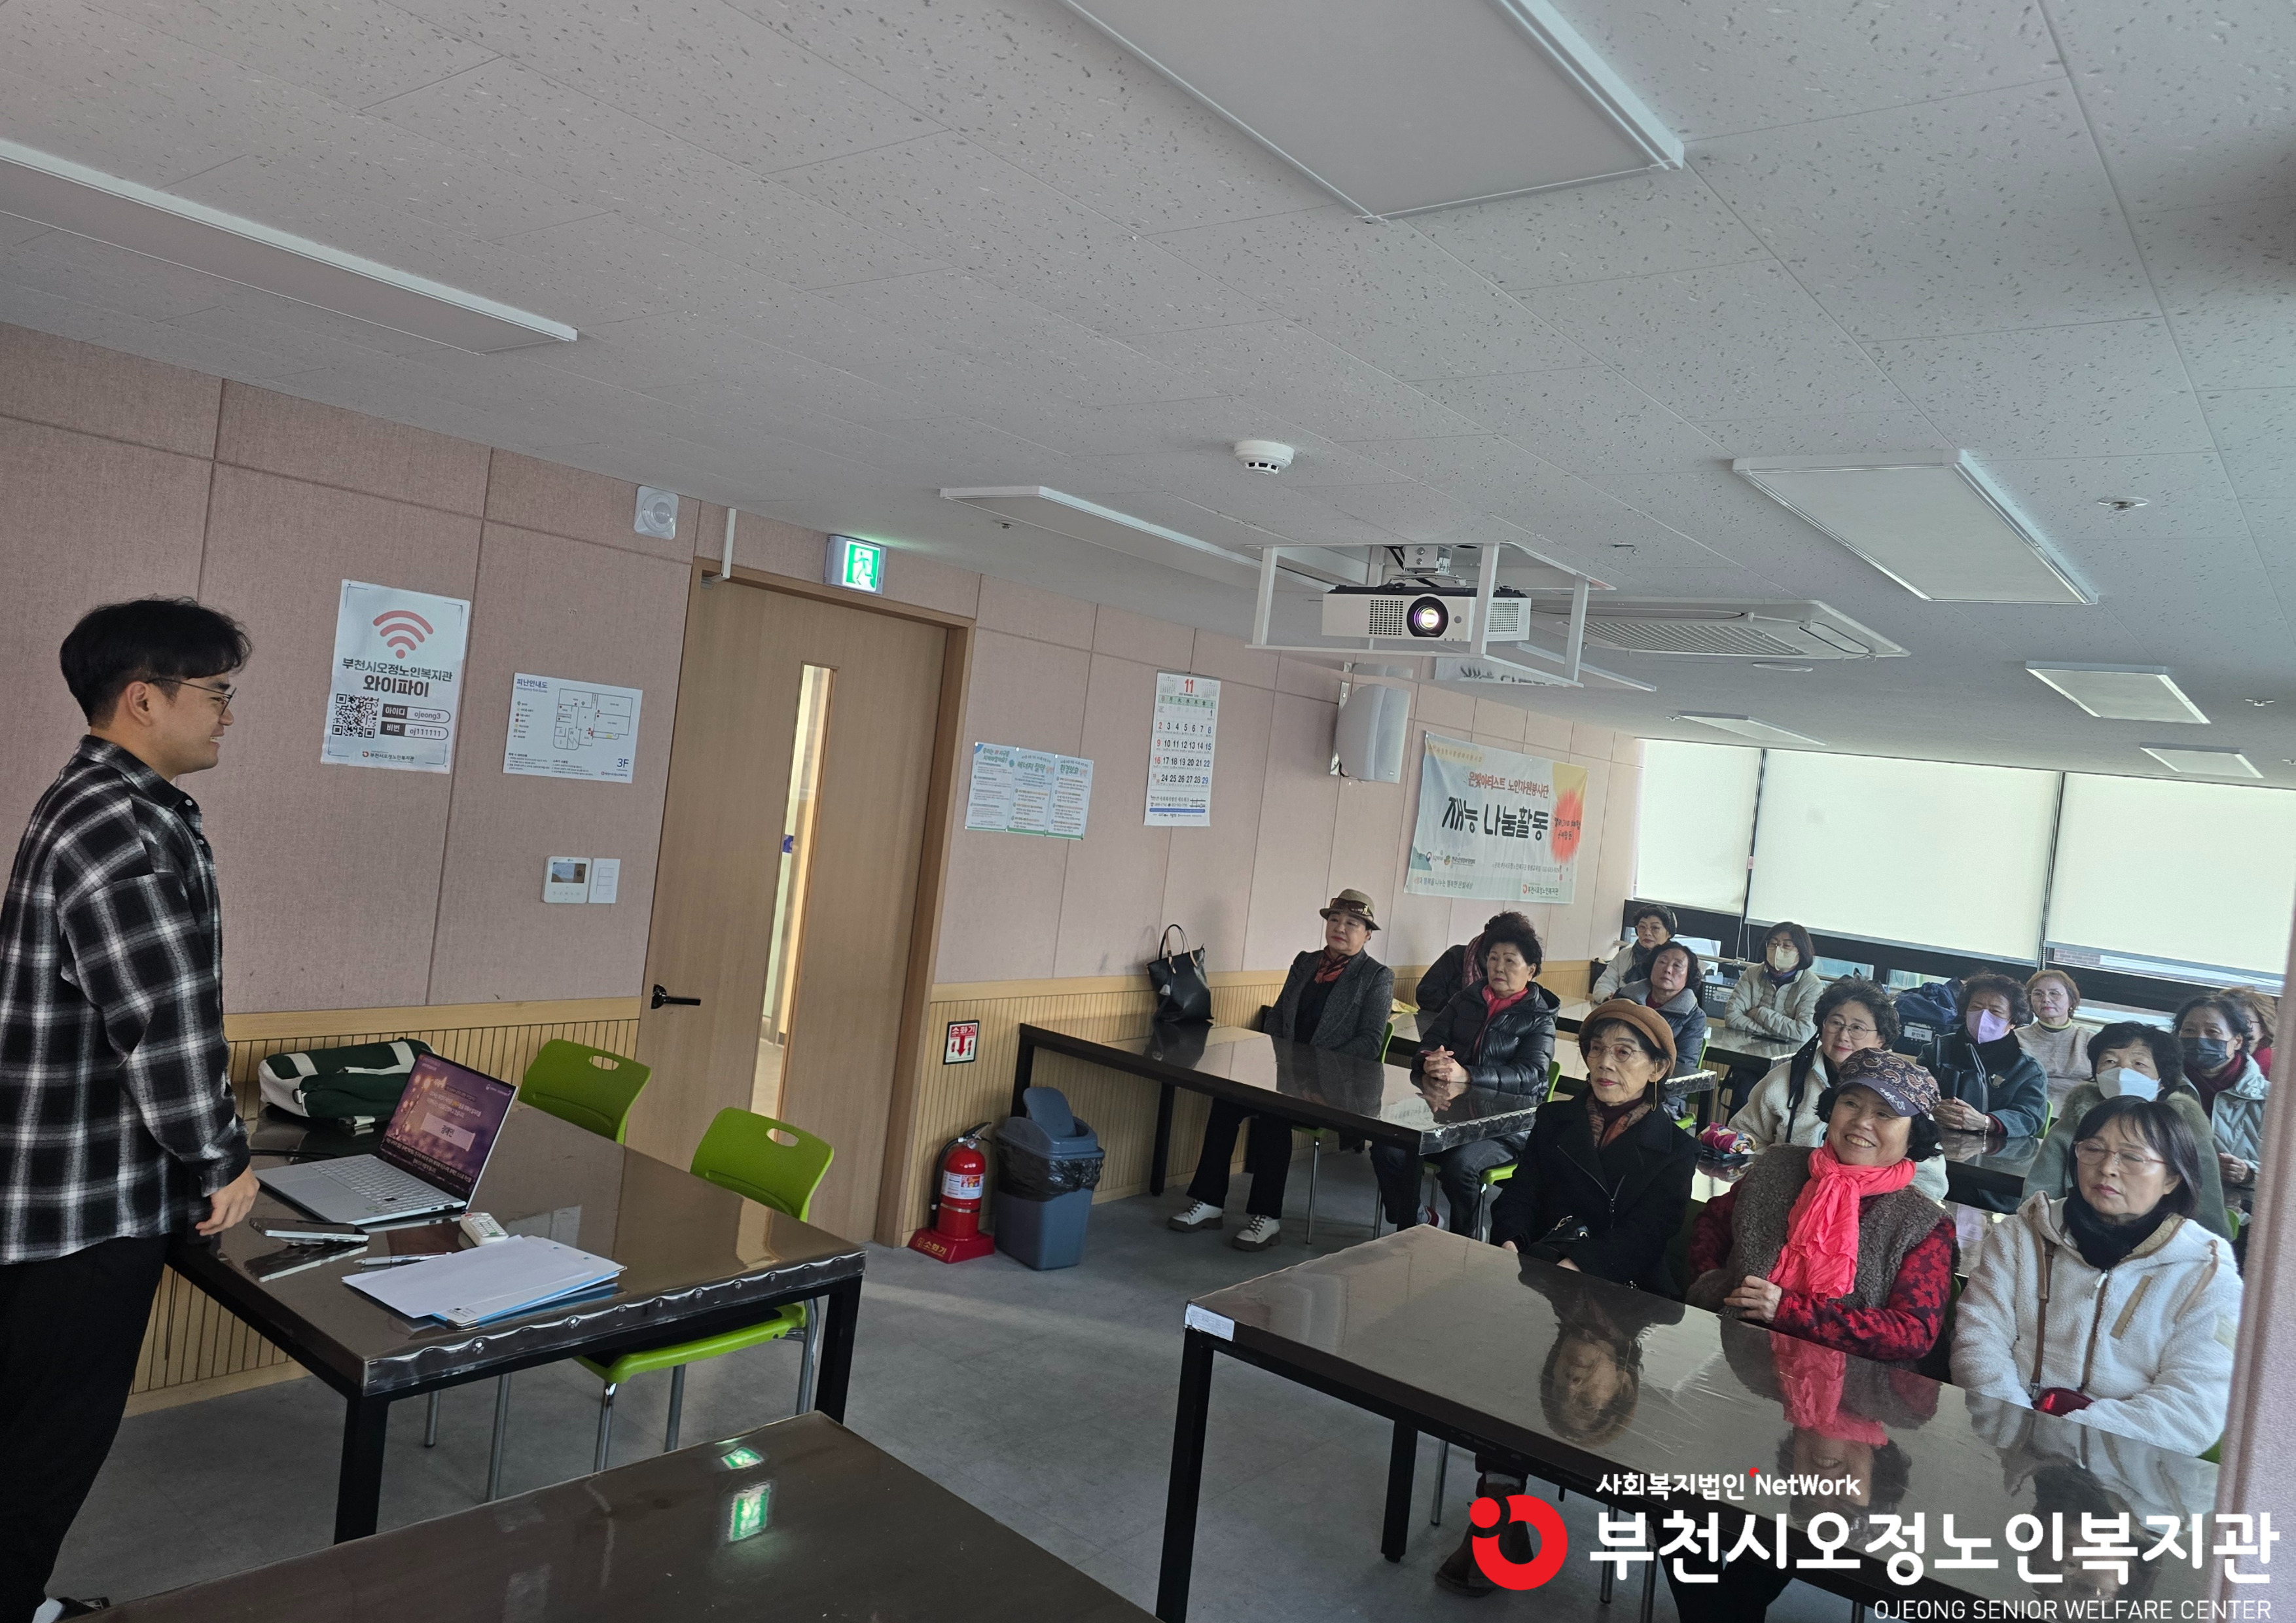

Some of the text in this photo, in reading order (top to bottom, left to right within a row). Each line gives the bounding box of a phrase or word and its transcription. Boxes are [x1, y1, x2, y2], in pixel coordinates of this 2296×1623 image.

[342, 658, 452, 682] 부천시오정노인복지관
[363, 675, 429, 697] 와이파이
[1185, 679, 1194, 693] 11
[385, 707, 405, 715] 아이디
[414, 711, 440, 720] ojeong3
[386, 724, 400, 732] 비번
[410, 728, 440, 737] oj111111
[617, 758, 629, 768] 3F
[1017, 761, 1034, 770] 에너지
[1035, 763, 1046, 774] 절약
[1060, 764, 1079, 775] 환경보호
[1468, 772, 1549, 799] 은빛아티스트 노인자원봉사단
[1441, 796, 1549, 841] 재능 나눔활동
[952, 1026, 975, 1034] 소화기
[924, 1241, 947, 1255] 소화기
